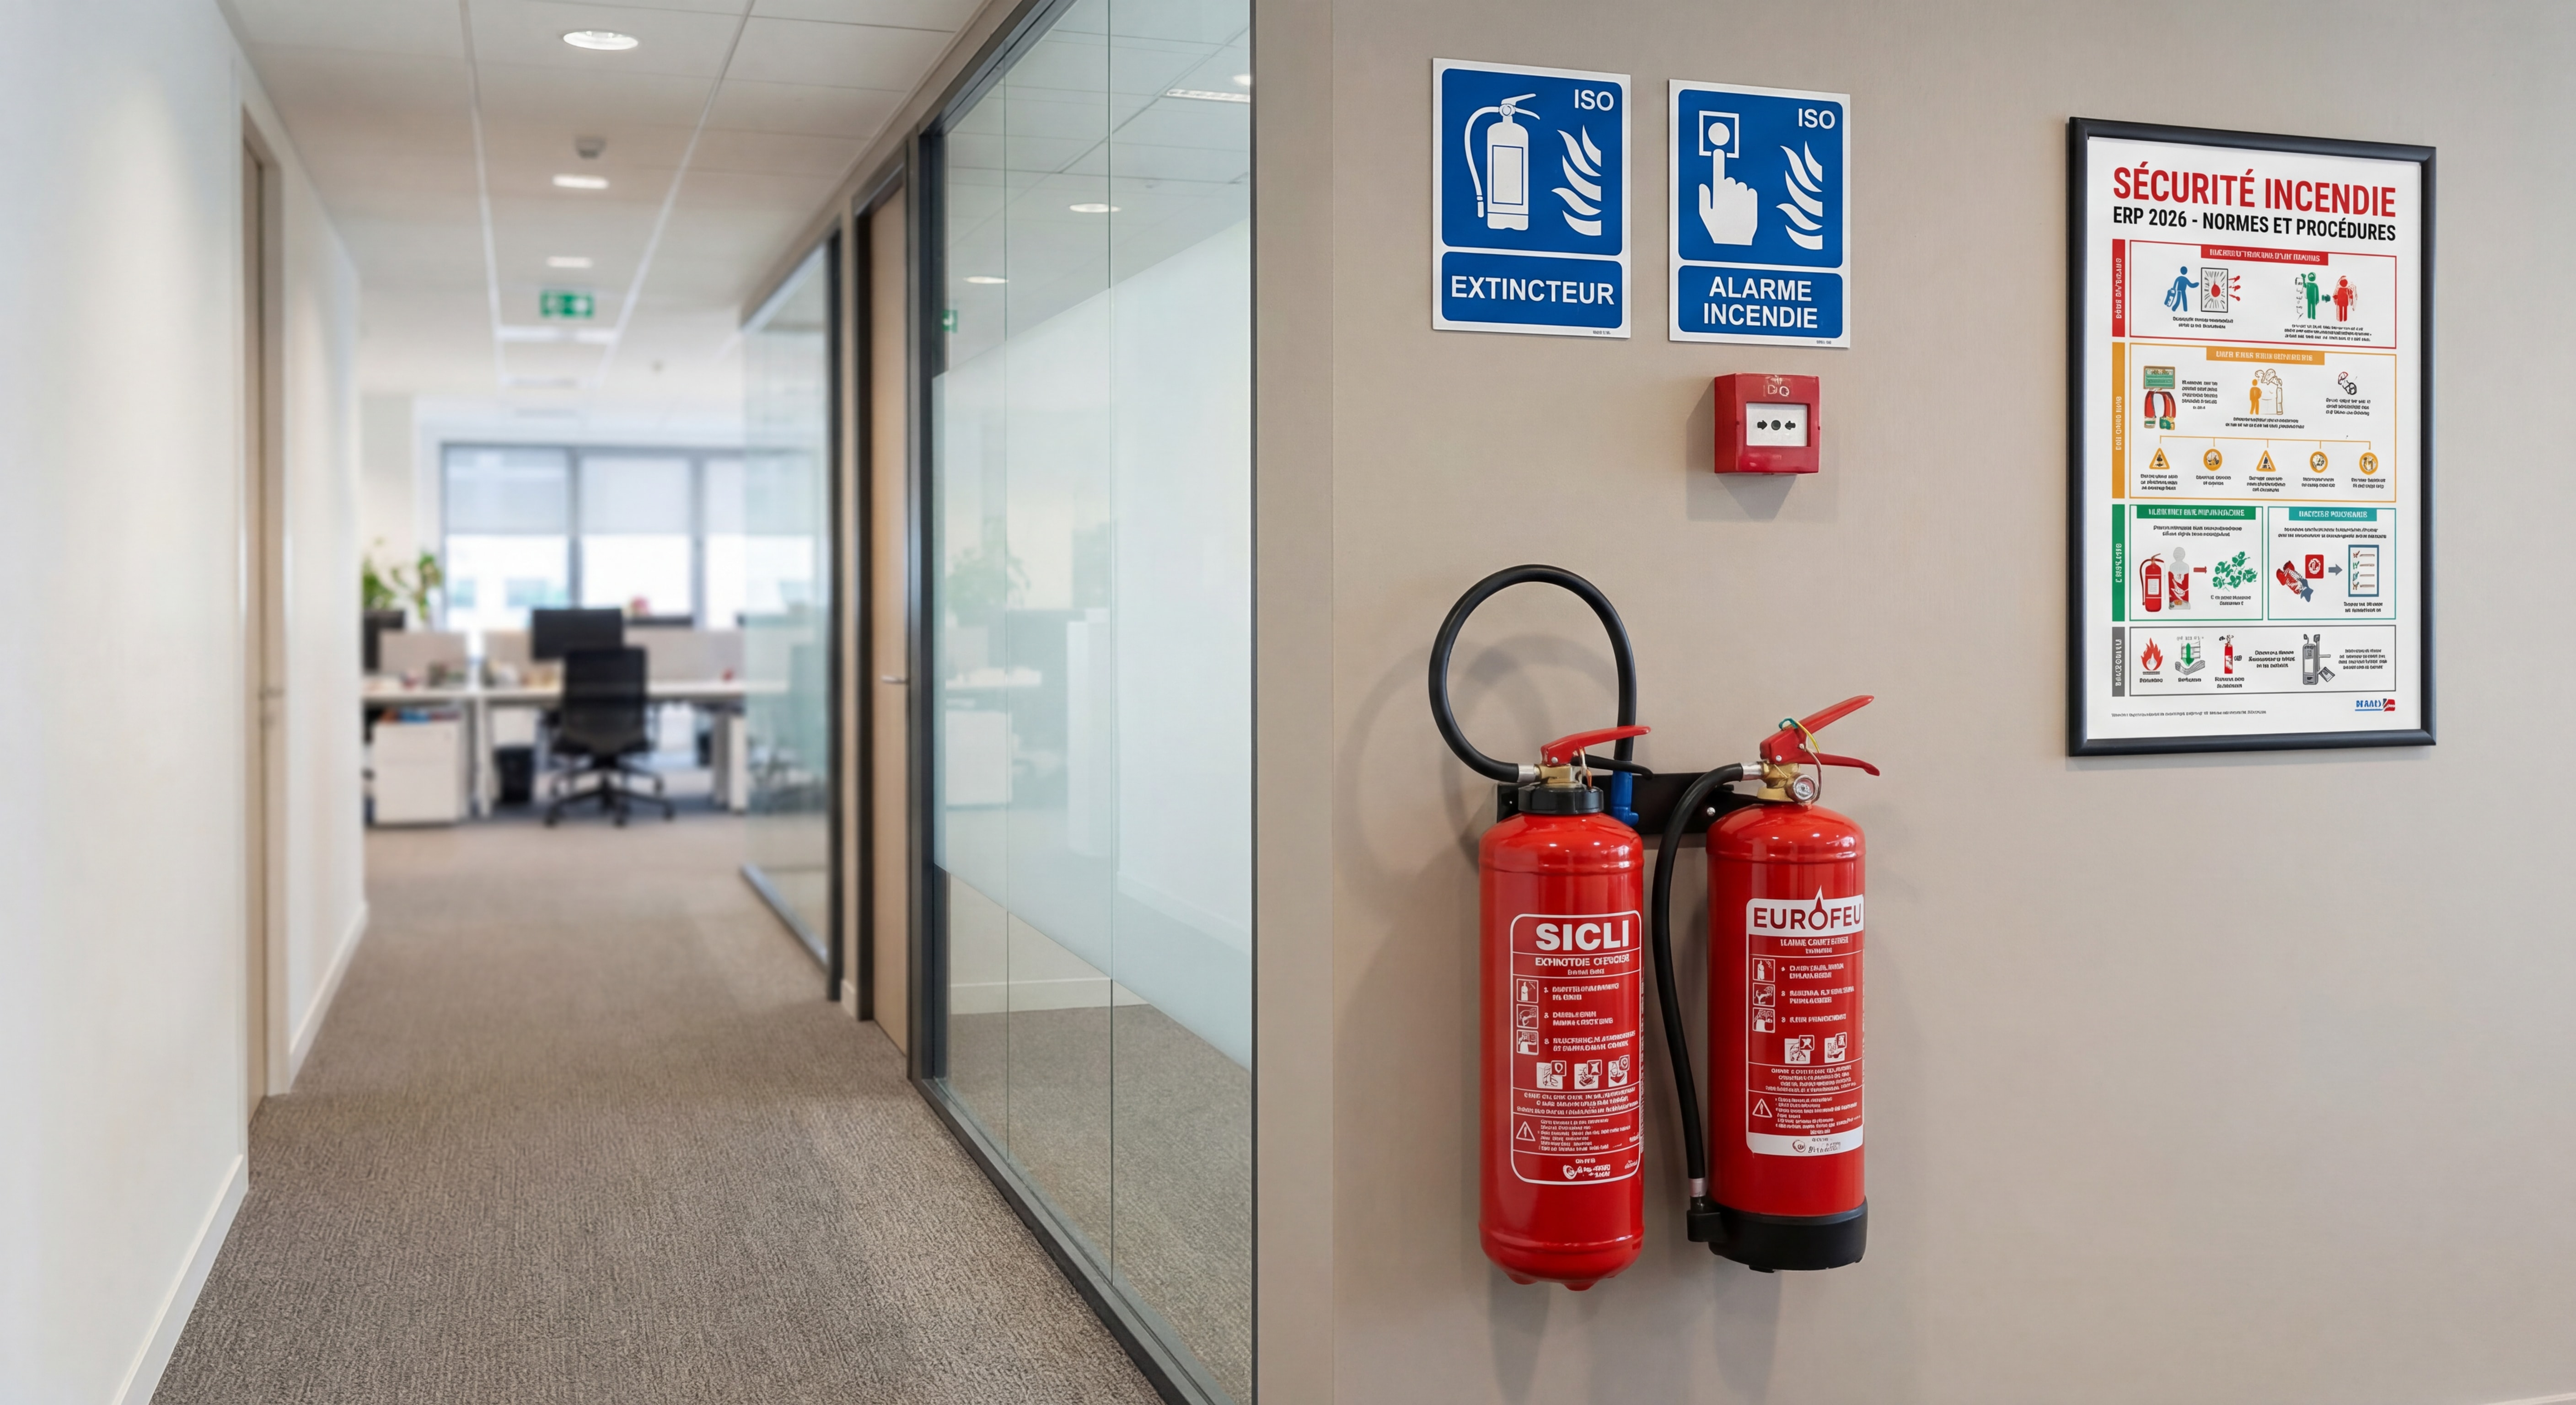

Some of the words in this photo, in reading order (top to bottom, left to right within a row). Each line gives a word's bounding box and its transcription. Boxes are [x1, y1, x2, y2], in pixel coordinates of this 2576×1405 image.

[1574, 89, 1614, 111] ISO
[1798, 108, 1835, 129] ISO
[2114, 161, 2255, 208] SÉCURITÉ
[2265, 178, 2396, 218] INCENDIE
[2114, 206, 2144, 225] ERP
[2149, 208, 2187, 227] 2026
[2203, 212, 2269, 233] NORMES
[2274, 217, 2292, 234] ET
[2297, 217, 2396, 241] PROCÉDURES
[1451, 275, 1615, 305] EXTINCTEUR
[1709, 276, 1812, 301] ALARME
[1704, 303, 1818, 328] INCENDIE
[1754, 902, 1861, 931] EUROFEU
[1535, 919, 1630, 951] SICLI
